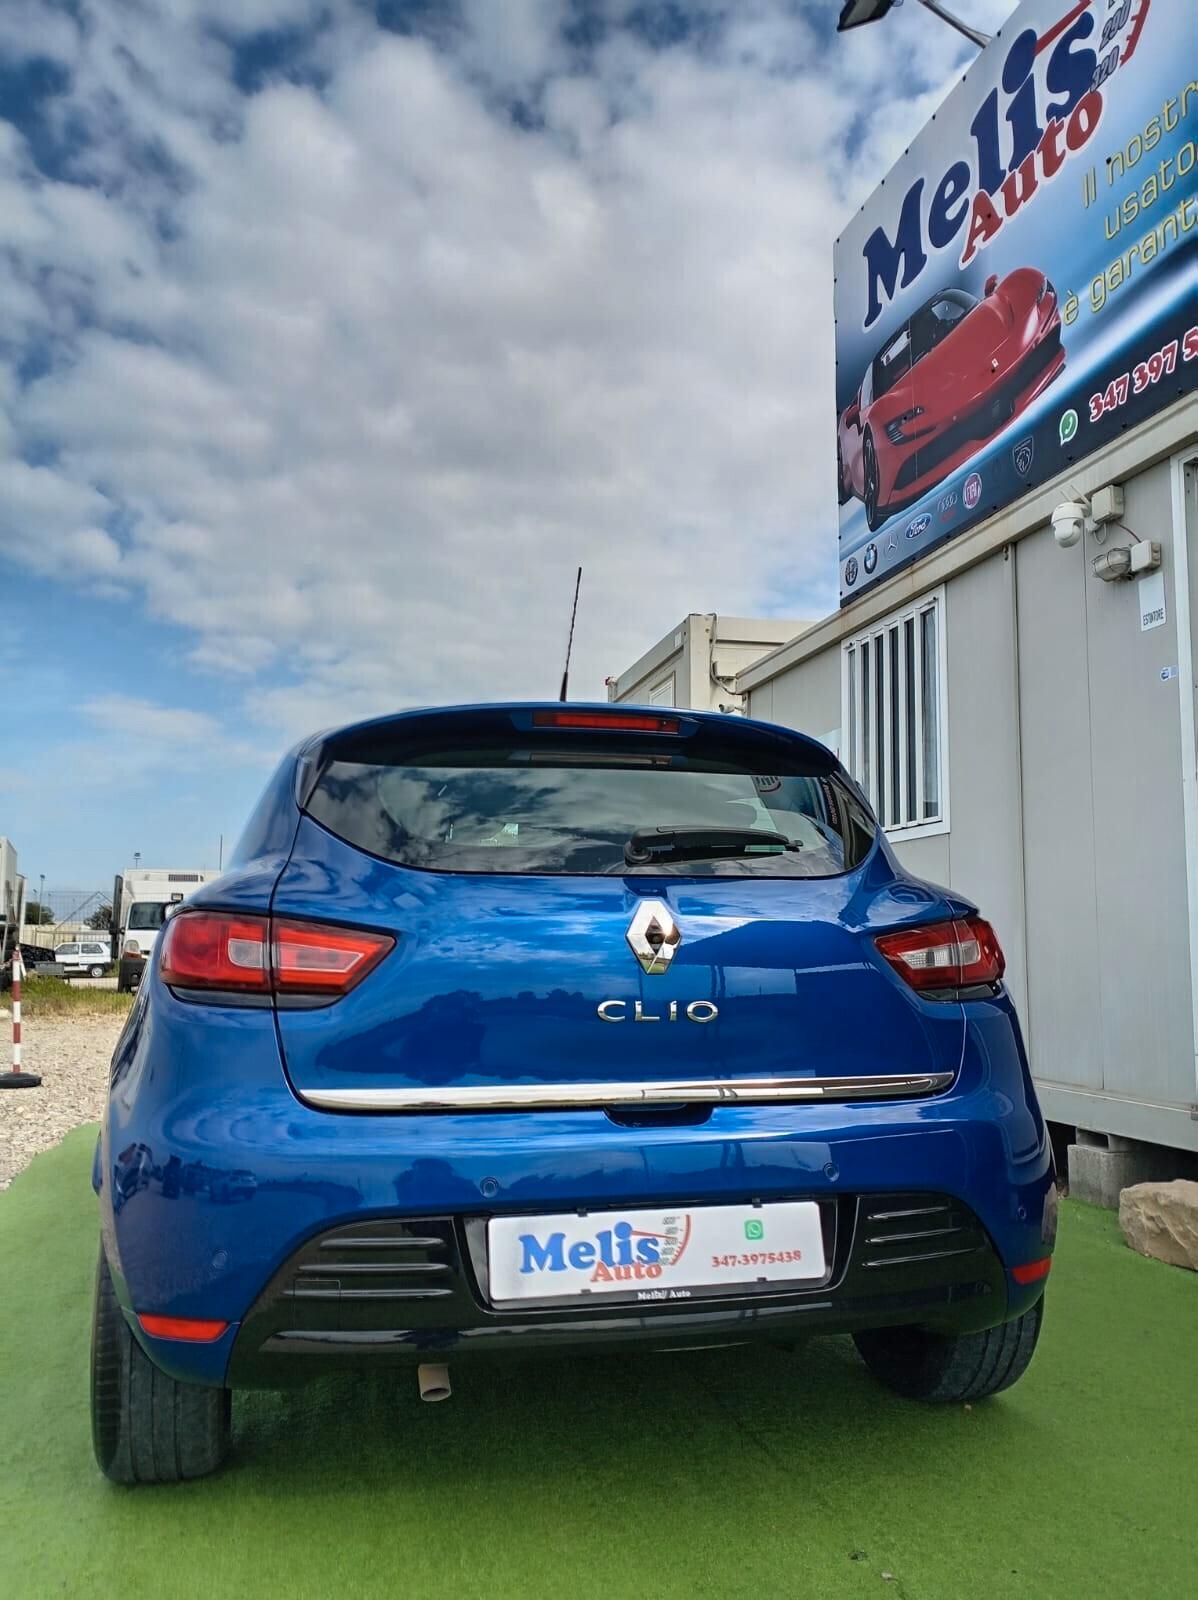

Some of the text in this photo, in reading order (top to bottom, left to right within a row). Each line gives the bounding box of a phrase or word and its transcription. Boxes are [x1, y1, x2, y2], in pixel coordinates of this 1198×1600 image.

[1090, 45, 1119, 93] 320
[862, 12, 1097, 328] Melis
[961, 90, 1103, 264] Auto
[1083, 81, 1198, 209] Il nostr
[1104, 141, 1196, 240] usato
[1063, 289, 1079, 326] è
[1089, 372, 1130, 422] 347
[1132, 339, 1178, 394] 397
[597, 1000, 719, 1022] CLIO
[518, 1221, 660, 1274] Melis
[590, 1261, 663, 1283] Auto
